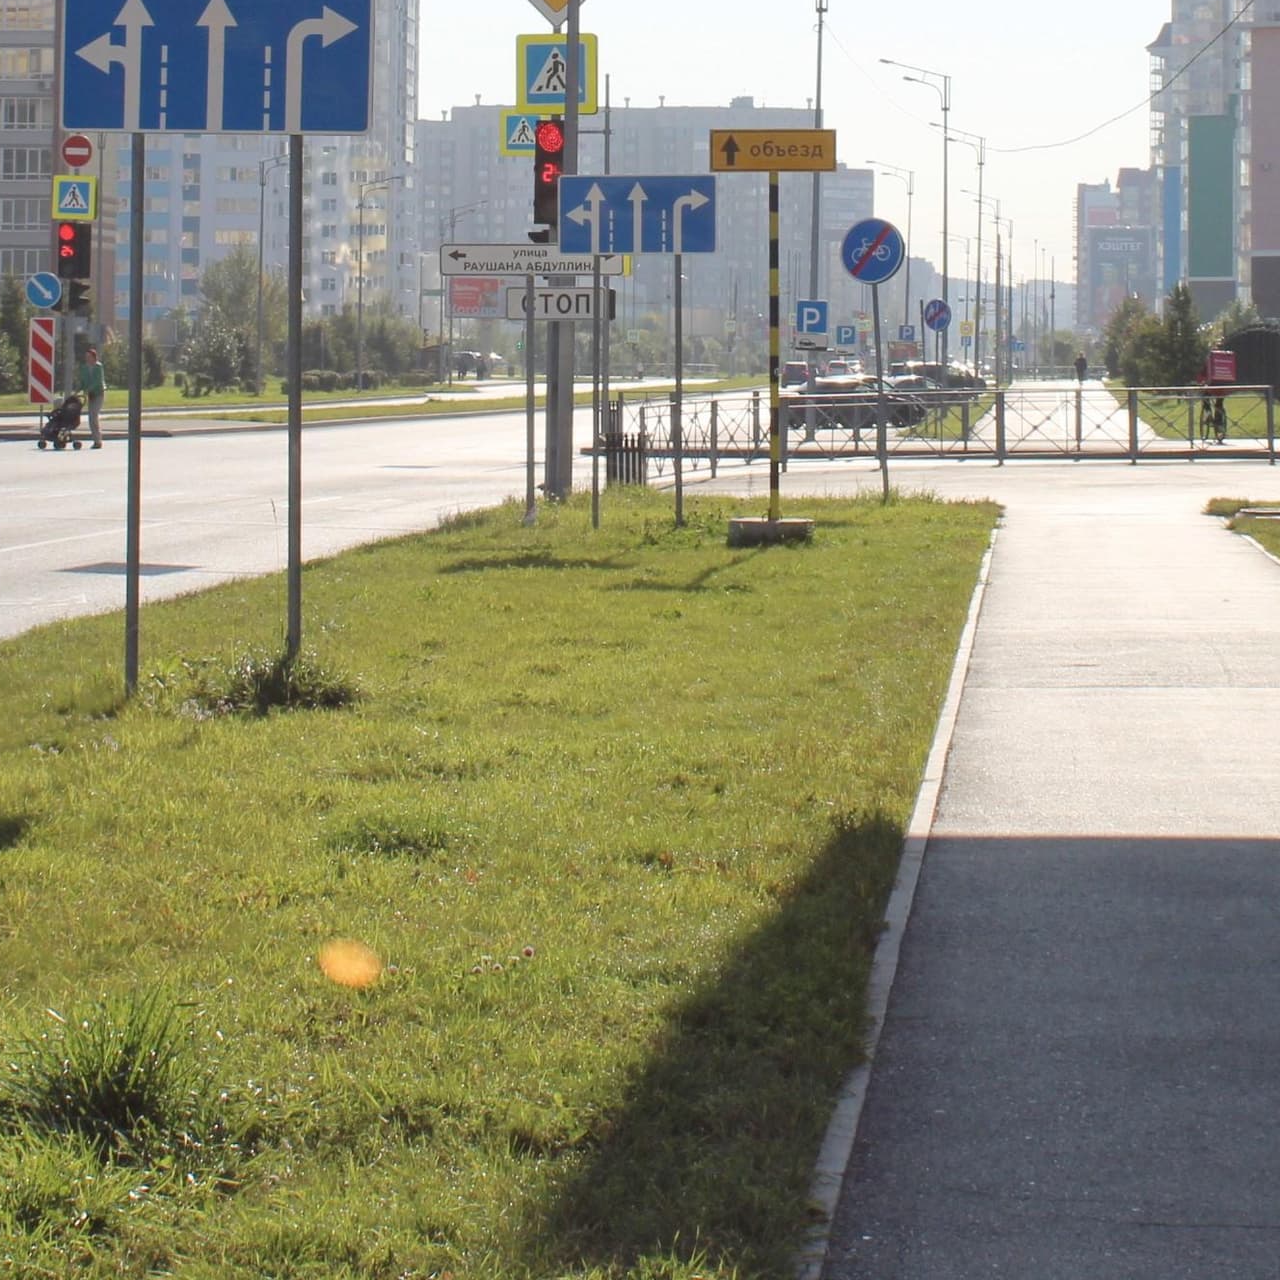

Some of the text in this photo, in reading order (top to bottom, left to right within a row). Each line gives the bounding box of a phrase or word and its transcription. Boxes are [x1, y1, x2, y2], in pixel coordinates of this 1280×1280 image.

[750, 140, 825, 158] объезд
[513, 249, 548, 259] улица
[463, 261, 596, 273] РАУШАНА АБДУЛЛИН
